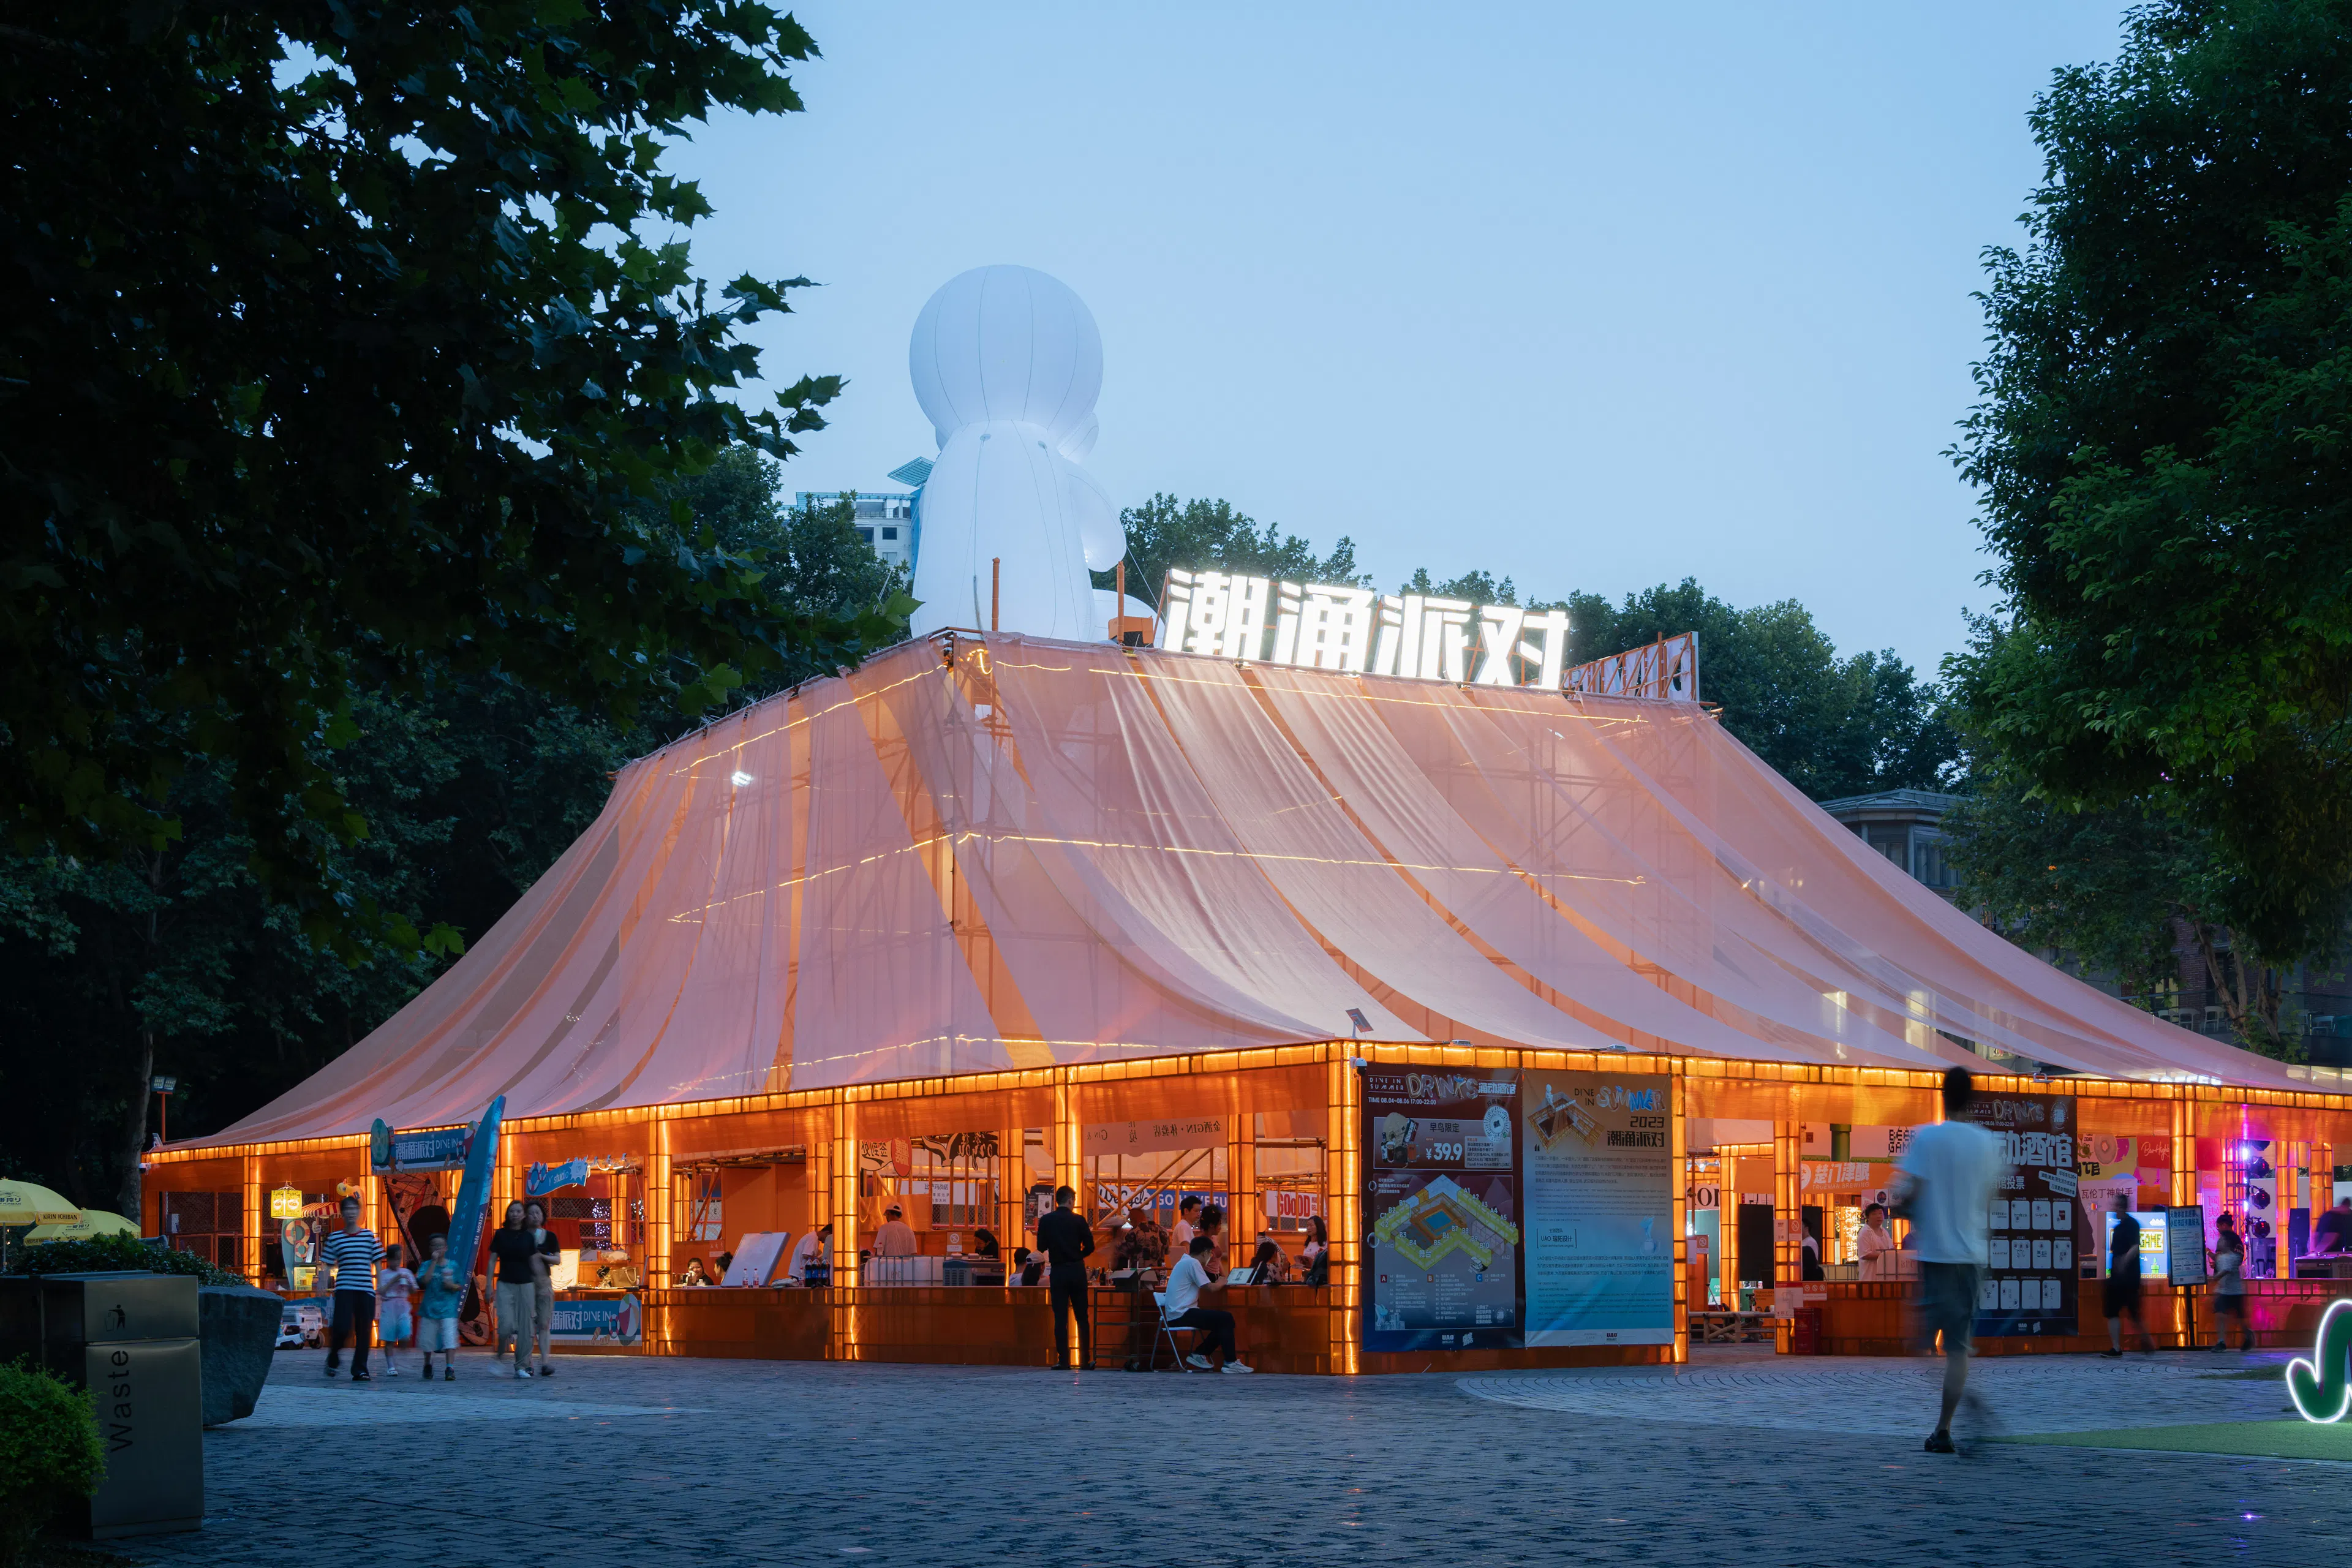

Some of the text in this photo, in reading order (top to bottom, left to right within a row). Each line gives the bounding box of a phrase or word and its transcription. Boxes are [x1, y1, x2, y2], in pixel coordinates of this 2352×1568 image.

[1163, 568, 1569, 689] 潮涌派对
[1405, 1072, 1479, 1099] DRINKS
[1574, 1088, 1594, 1097] DIVE
[1585, 1098, 1594, 1106] IN
[1596, 1085, 1666, 1112] SUMMER
[1992, 1099, 2045, 1121] DRINKS
[1430, 1122, 1459, 1133] 早鸟限定
[1630, 1116, 1665, 1128] 2023
[1607, 1130, 1665, 1148] 潮涌派对
[1992, 1130, 2073, 1167] 动酒馆
[396, 1140, 435, 1161] 潮涌派对
[435, 1139, 450, 1150] DIVE
[2081, 1187, 2133, 1199] 瓦伦丁神射手
[583, 1311, 600, 1322] DIVE
[110, 1350, 133, 1452] Waste
